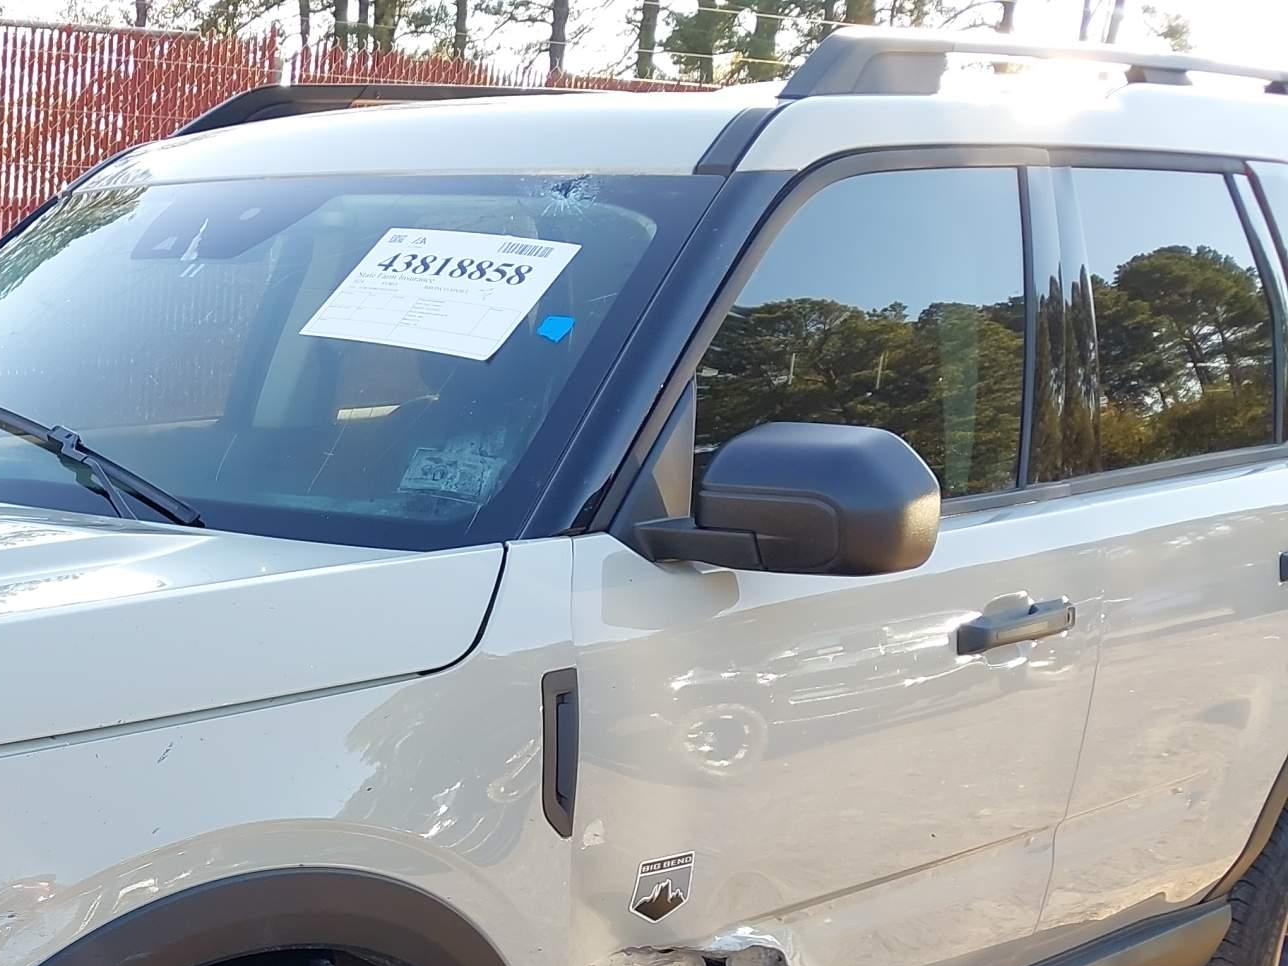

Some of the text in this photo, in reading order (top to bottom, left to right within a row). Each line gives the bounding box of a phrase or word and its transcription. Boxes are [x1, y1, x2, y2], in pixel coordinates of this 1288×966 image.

[377, 252, 533, 285] 43818858
[642, 856, 692, 872] BIG BEND
